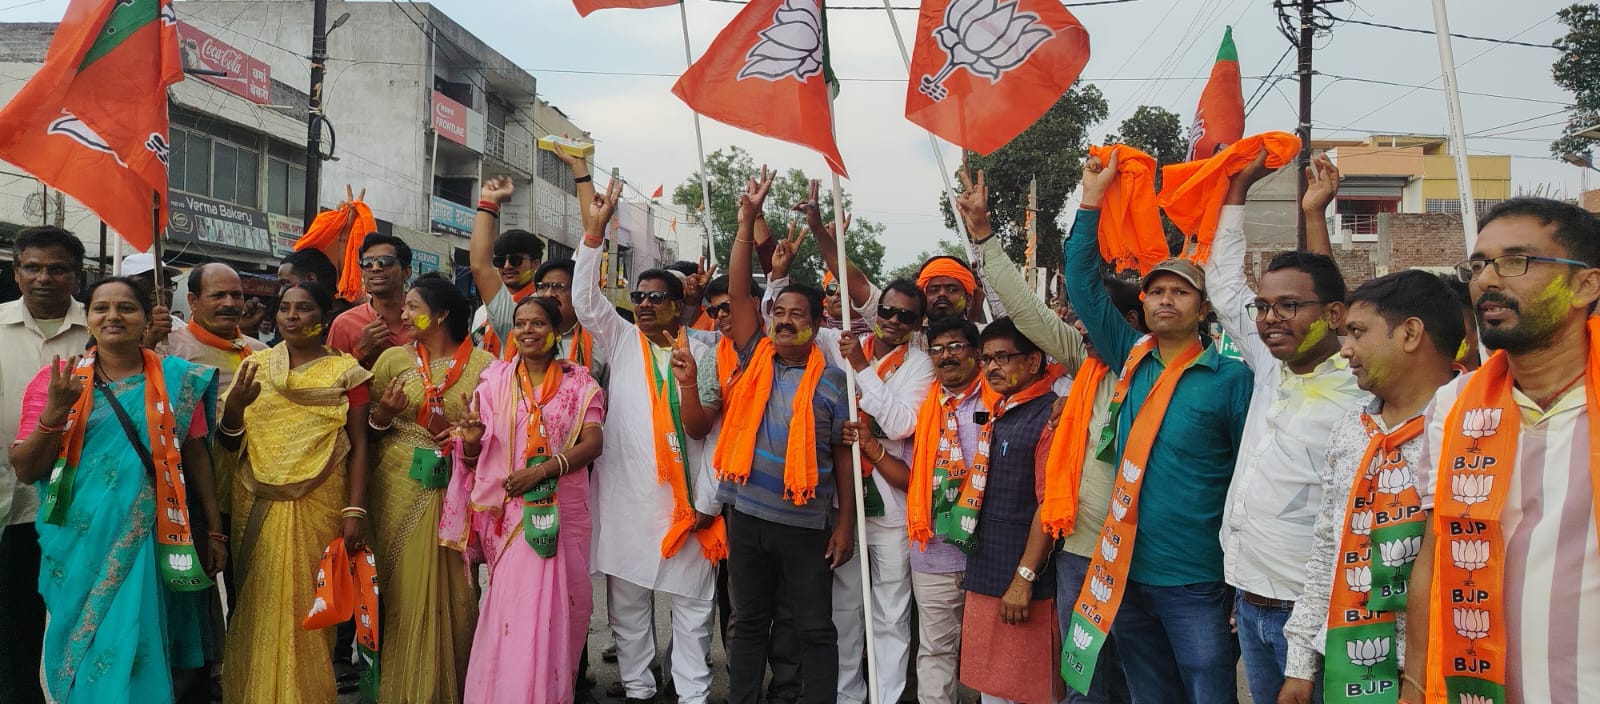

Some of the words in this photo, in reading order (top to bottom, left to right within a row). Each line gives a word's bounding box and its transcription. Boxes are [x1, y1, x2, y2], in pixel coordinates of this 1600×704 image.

[202, 39, 242, 74] Coca-Cola
[436, 116, 464, 138] FRONTLINE
[186, 197, 218, 214] Verma
[219, 204, 252, 225] Bakery
[1453, 456, 1497, 470] BJP
[1354, 492, 1375, 509] BJ
[1375, 505, 1420, 525] BJP
[1450, 521, 1487, 536] BJP
[1345, 549, 1371, 564] BJ
[1381, 581, 1407, 598] BJ
[1452, 589, 1489, 604] BJP
[1453, 657, 1492, 673] BJP
[1345, 680, 1394, 697] BJP
